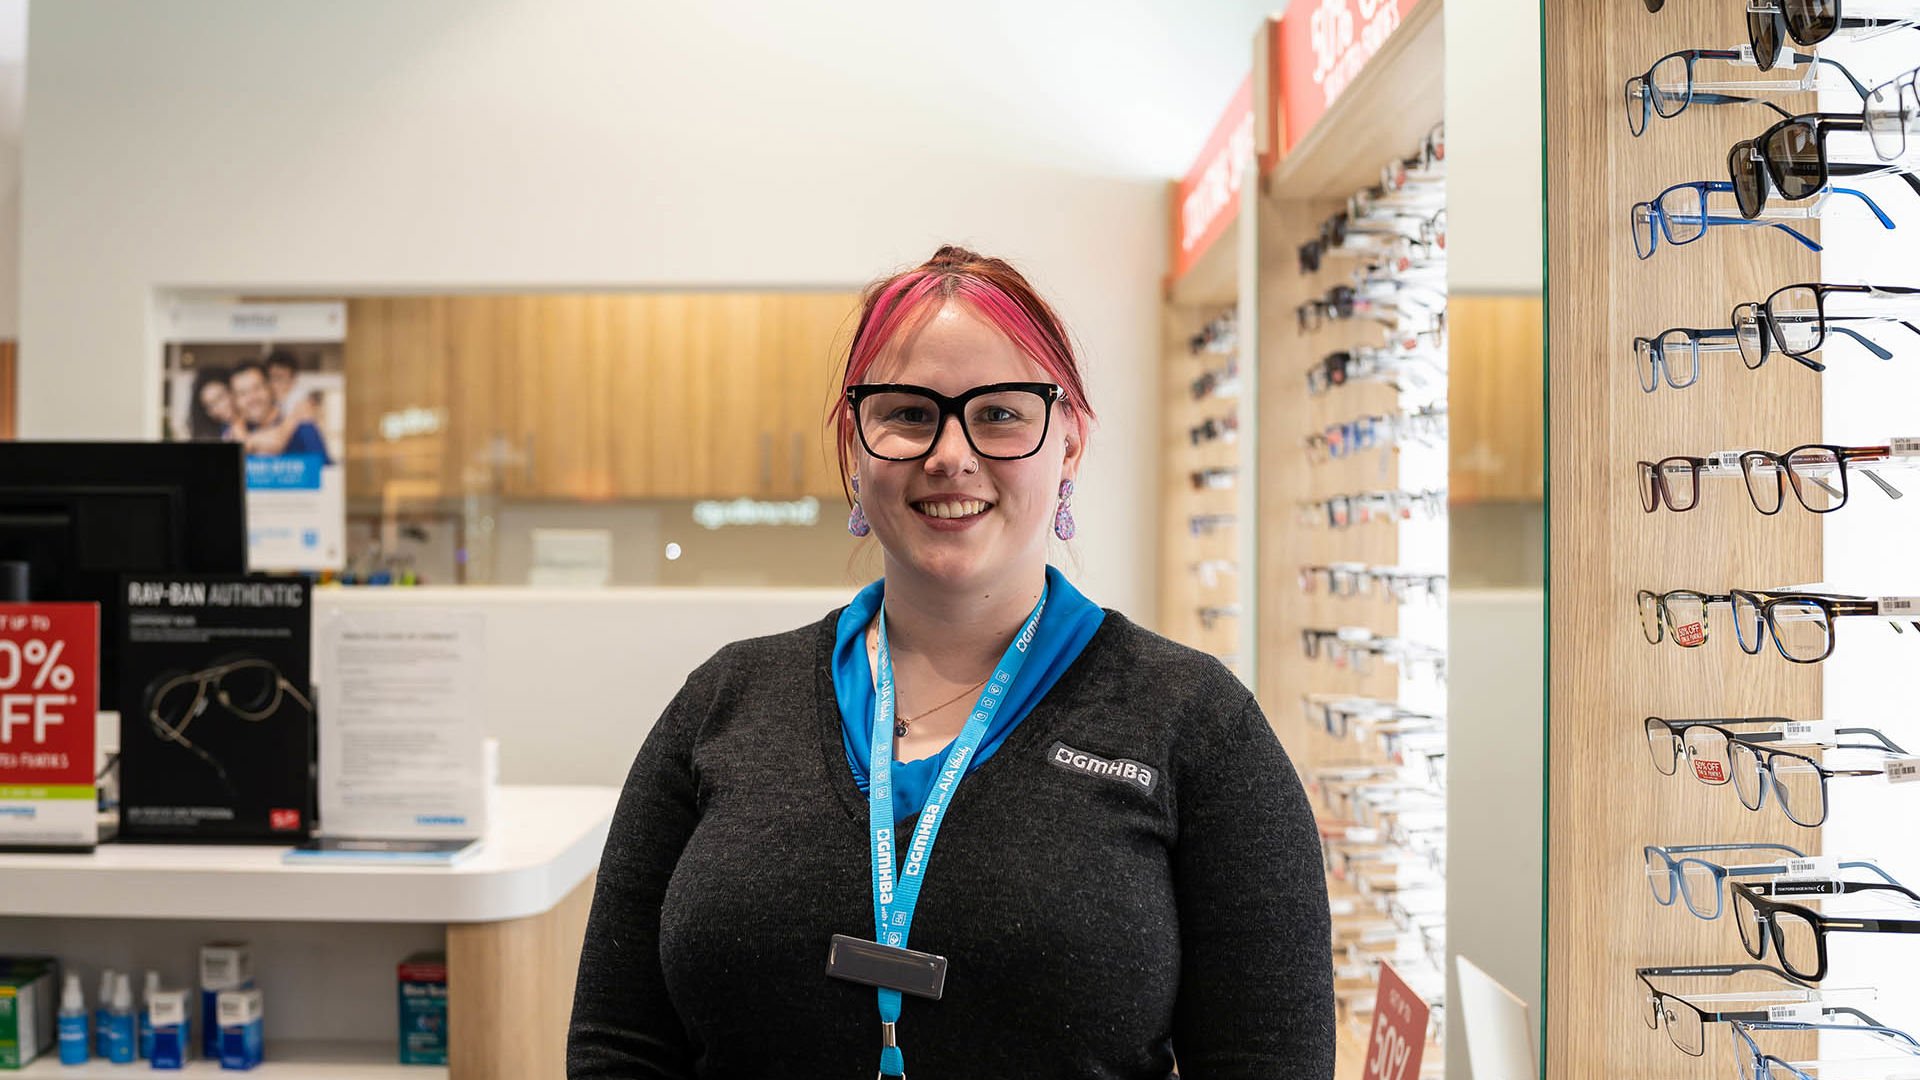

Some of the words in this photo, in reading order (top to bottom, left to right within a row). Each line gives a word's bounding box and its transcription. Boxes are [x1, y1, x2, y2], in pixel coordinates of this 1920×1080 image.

[128, 581, 206, 607] RAY-BAN
[207, 582, 303, 608] AUTHENTIC
[0, 638, 76, 691] 0%
[939, 769, 958, 792] AIA
